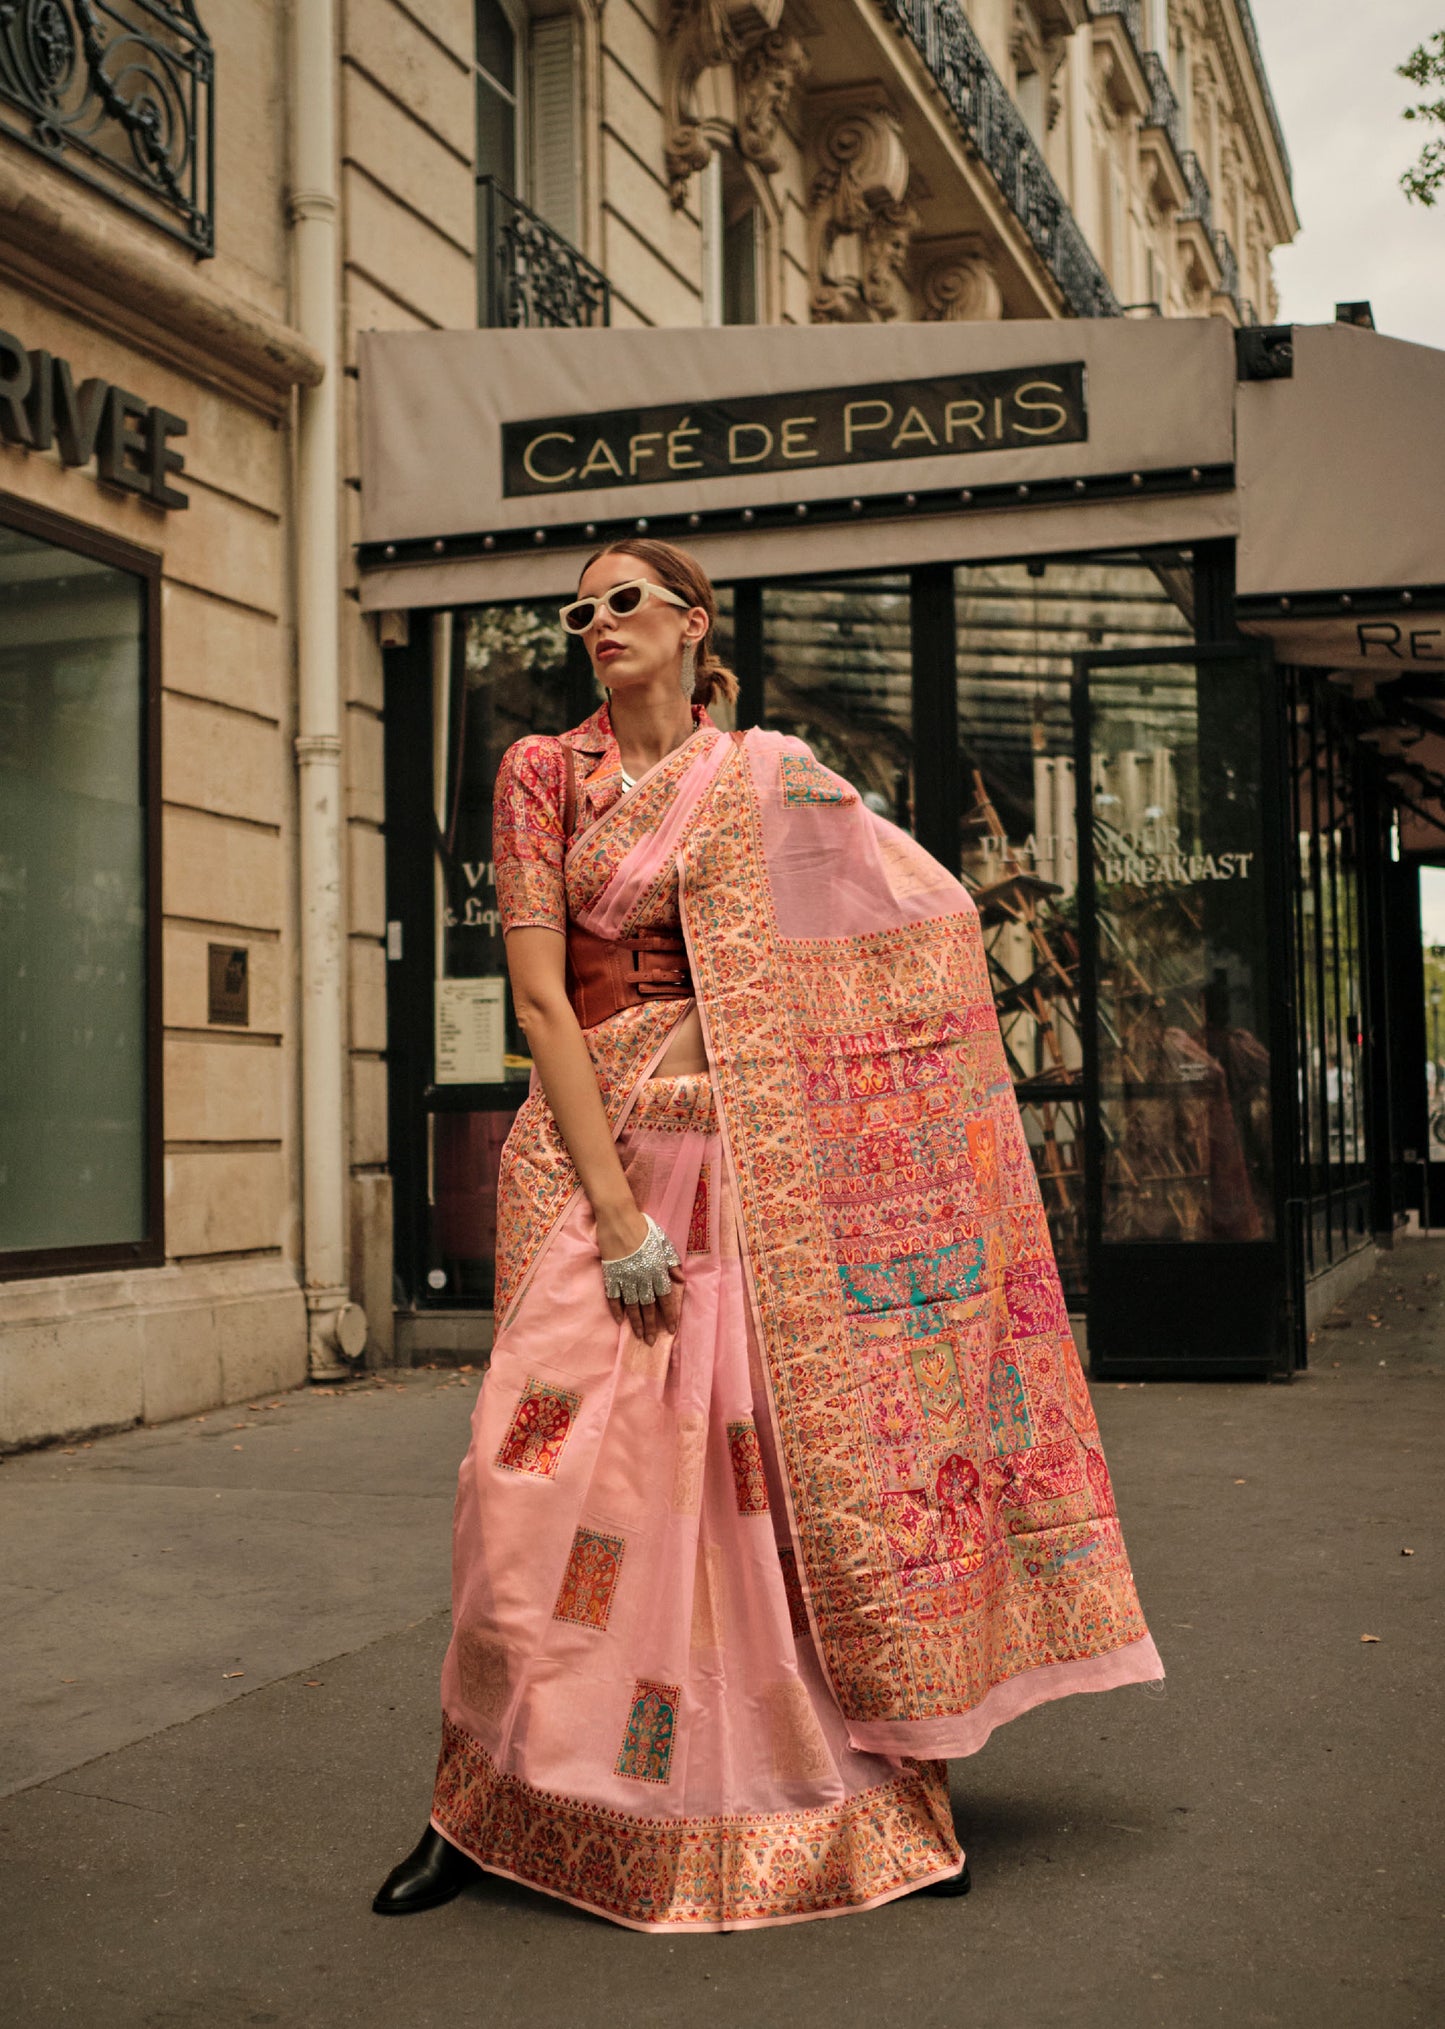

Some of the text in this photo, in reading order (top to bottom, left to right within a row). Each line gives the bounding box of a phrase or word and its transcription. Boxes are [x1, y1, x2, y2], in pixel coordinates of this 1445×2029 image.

[522, 380, 1069, 484] CAFÉ DE PARIS
[1356, 622, 1445, 662] RE
[1102, 851, 1254, 889] BREAKFAST
